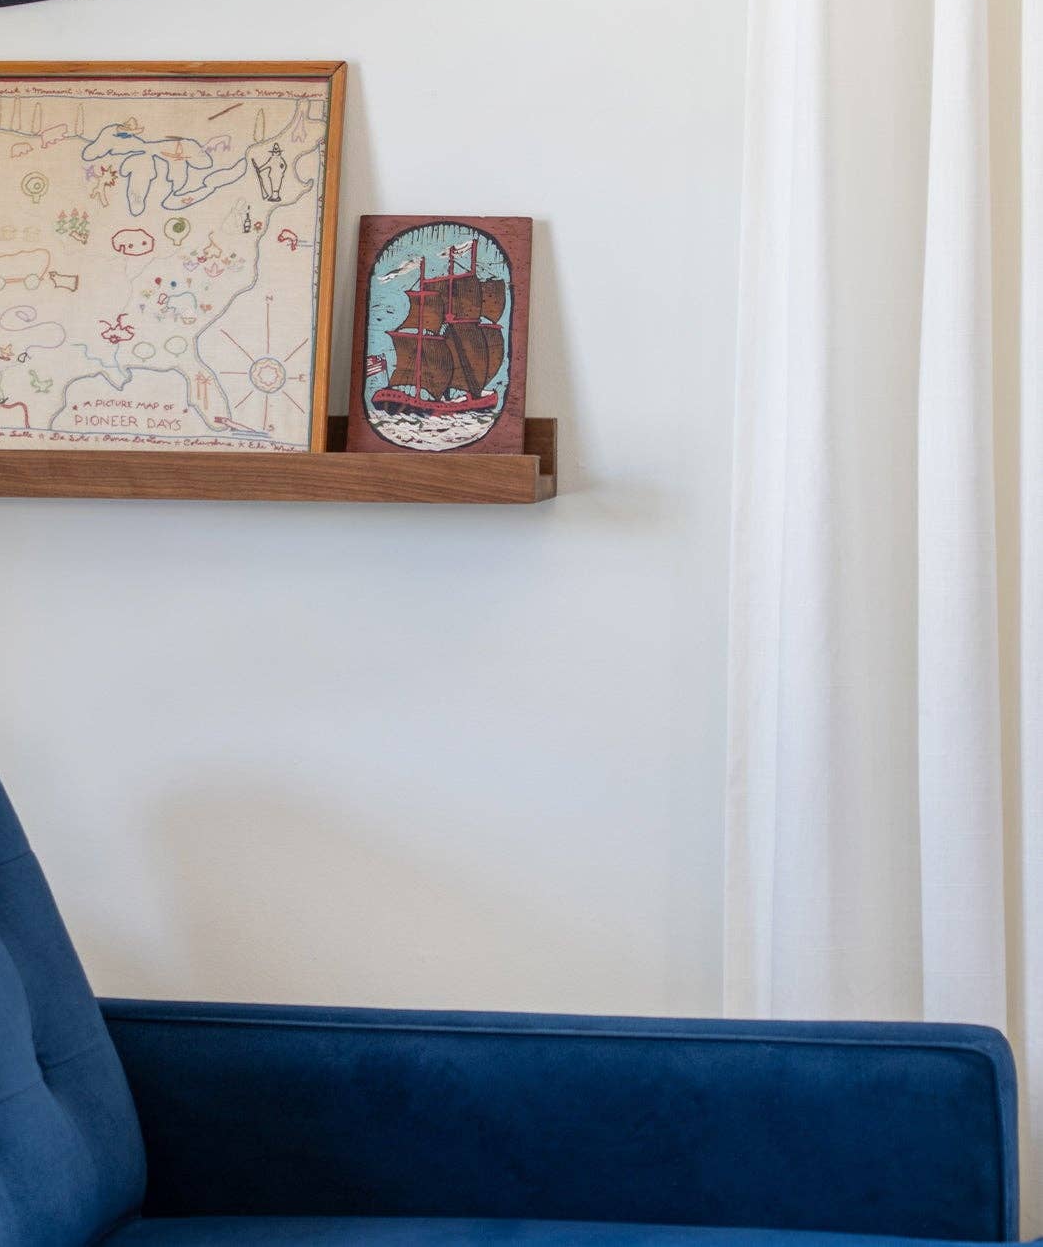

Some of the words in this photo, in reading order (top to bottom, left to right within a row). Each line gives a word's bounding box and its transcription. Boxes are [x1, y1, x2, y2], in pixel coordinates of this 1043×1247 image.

[95, 399, 133, 409] PICTURE
[136, 402, 160, 410] MAP
[74, 414, 139, 428] PIONEER
[147, 417, 182, 431] DAYS
